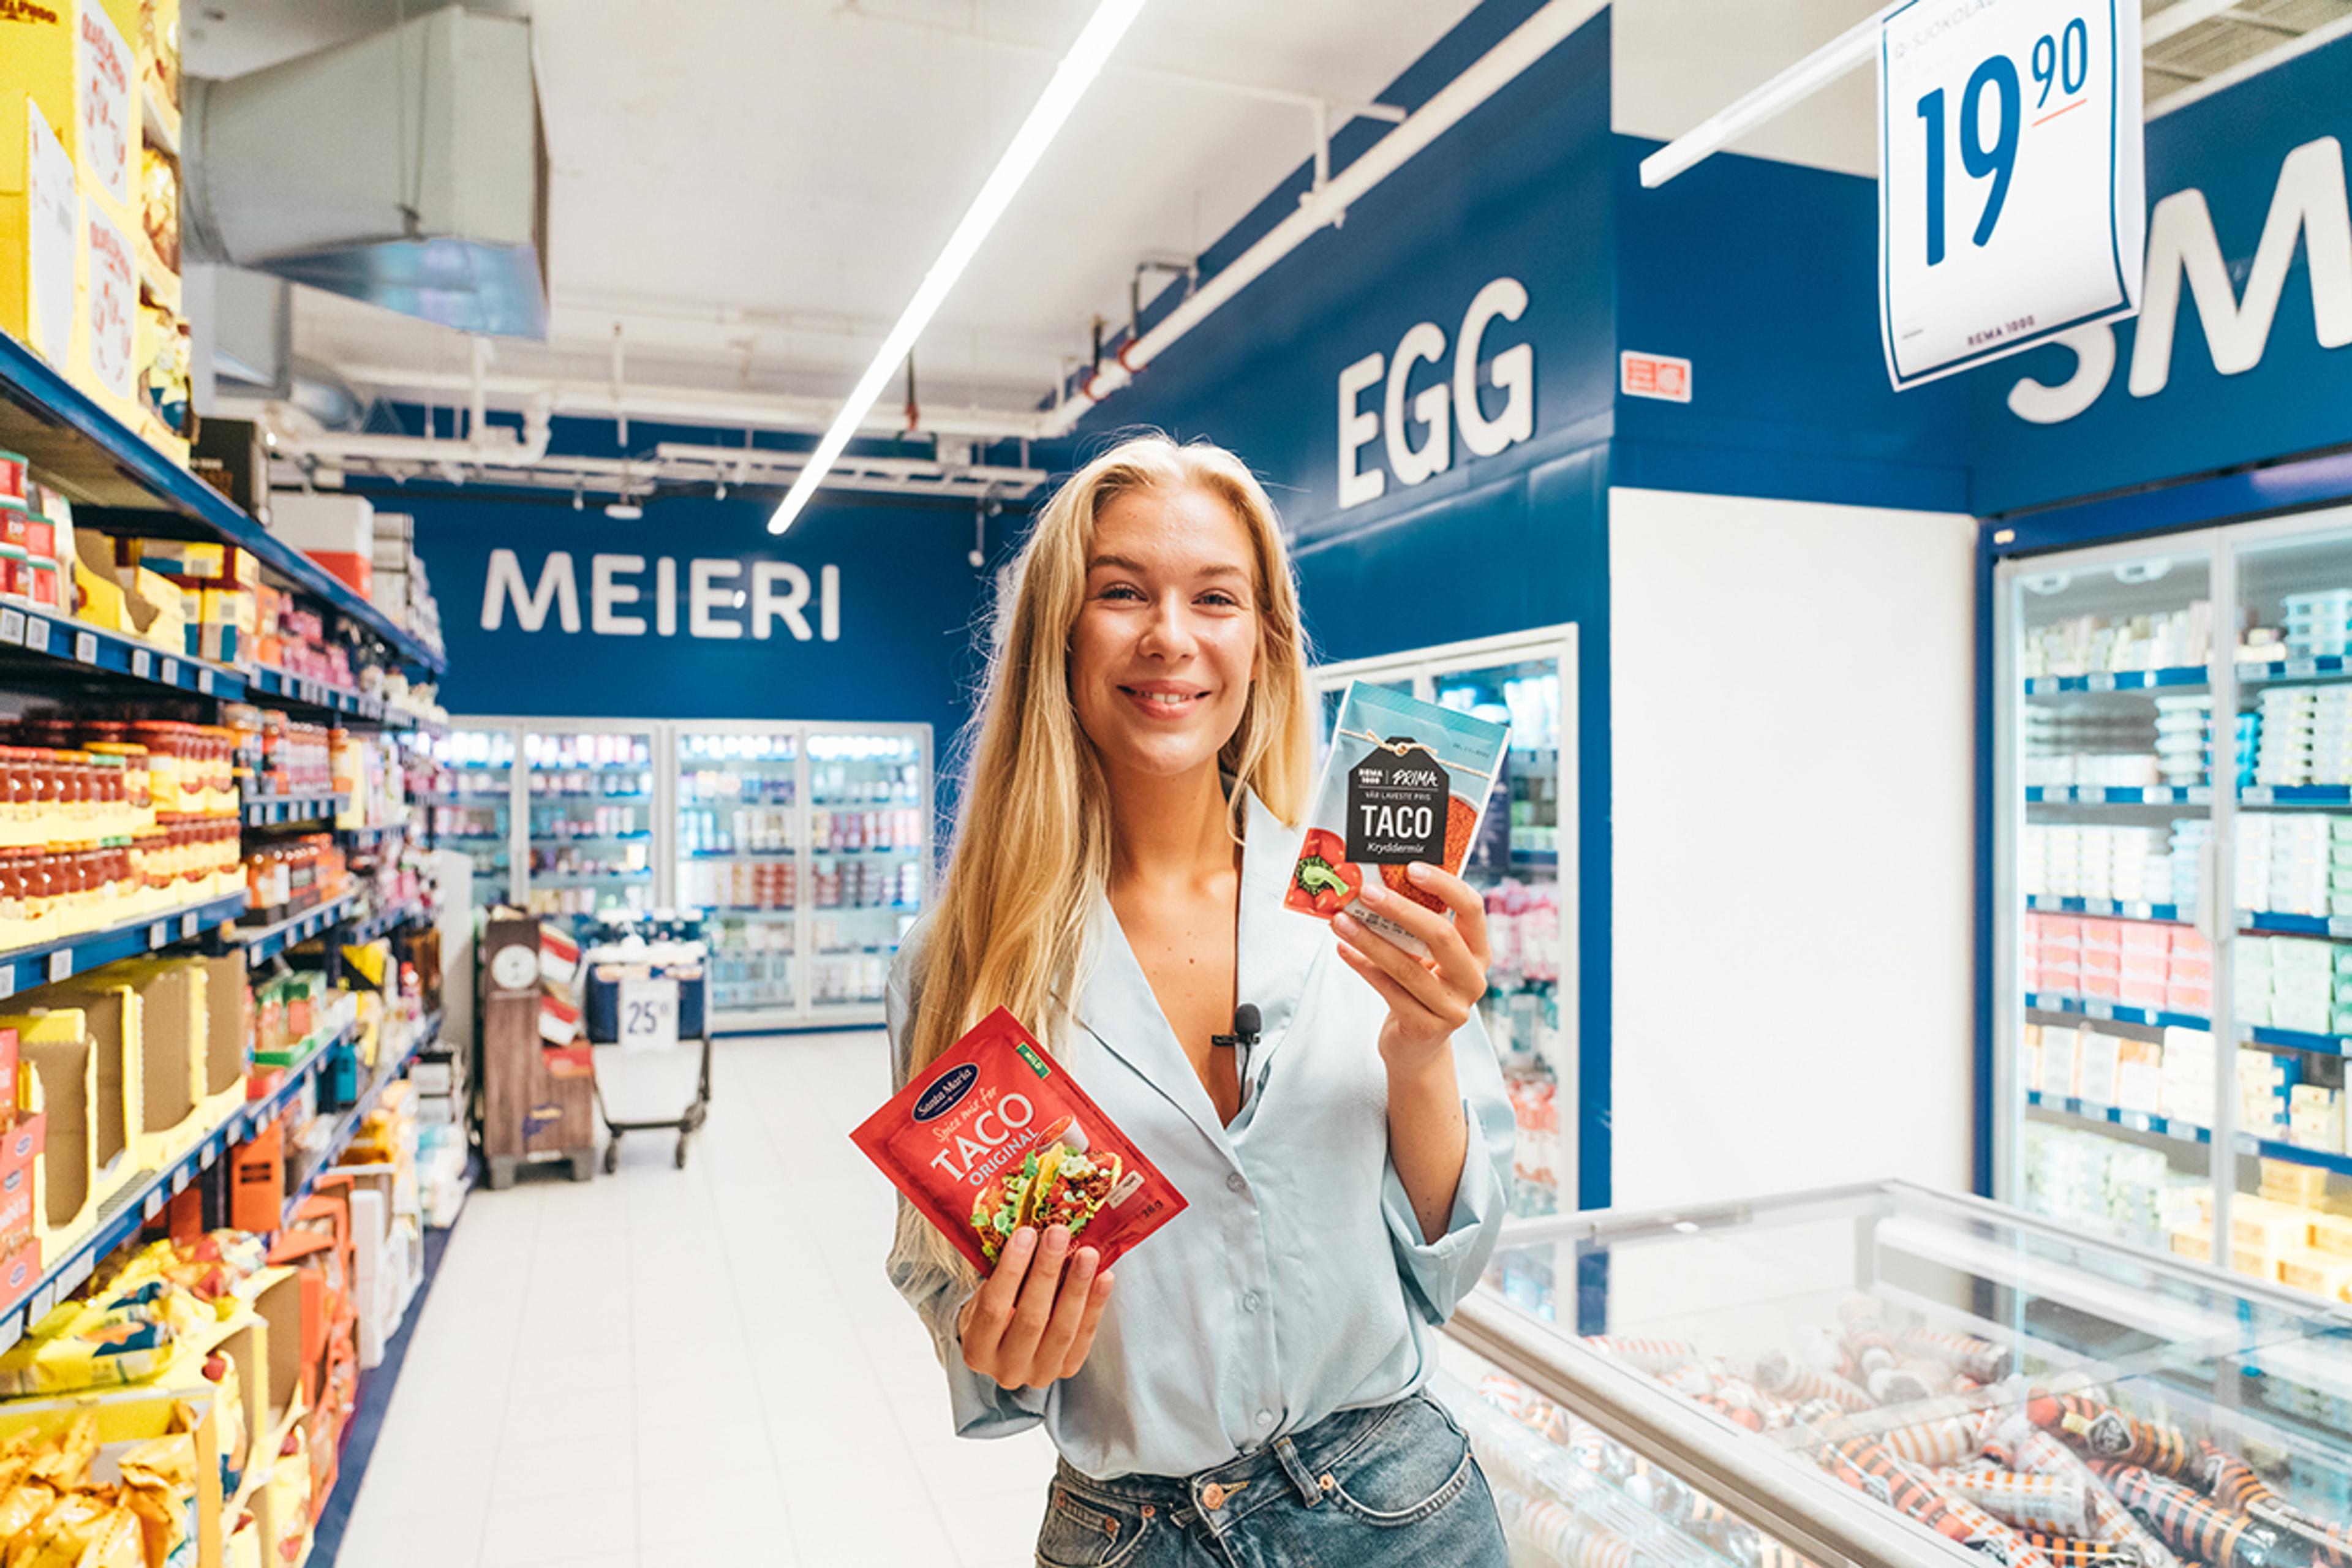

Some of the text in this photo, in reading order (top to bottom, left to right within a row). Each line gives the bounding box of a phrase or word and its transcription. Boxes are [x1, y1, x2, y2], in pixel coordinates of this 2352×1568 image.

[1917, 55, 2021, 266] 19
[1967, 314, 2035, 346] REMA 1000
[1338, 276, 1534, 510] EGG
[480, 548, 840, 642] MEIERI
[1392, 769, 1439, 787] PRIMA
[1360, 805, 1433, 839] TACO
[1366, 842, 1425, 854] Kryddermix
[627, 1000, 657, 1034] 25
[918, 1068, 972, 1116] Santa Maria
[932, 1117, 962, 1144] Spice
[979, 1086, 997, 1107] for
[930, 1093, 1034, 1182] TACO
[969, 1128, 1039, 1186] ORIGINAL
